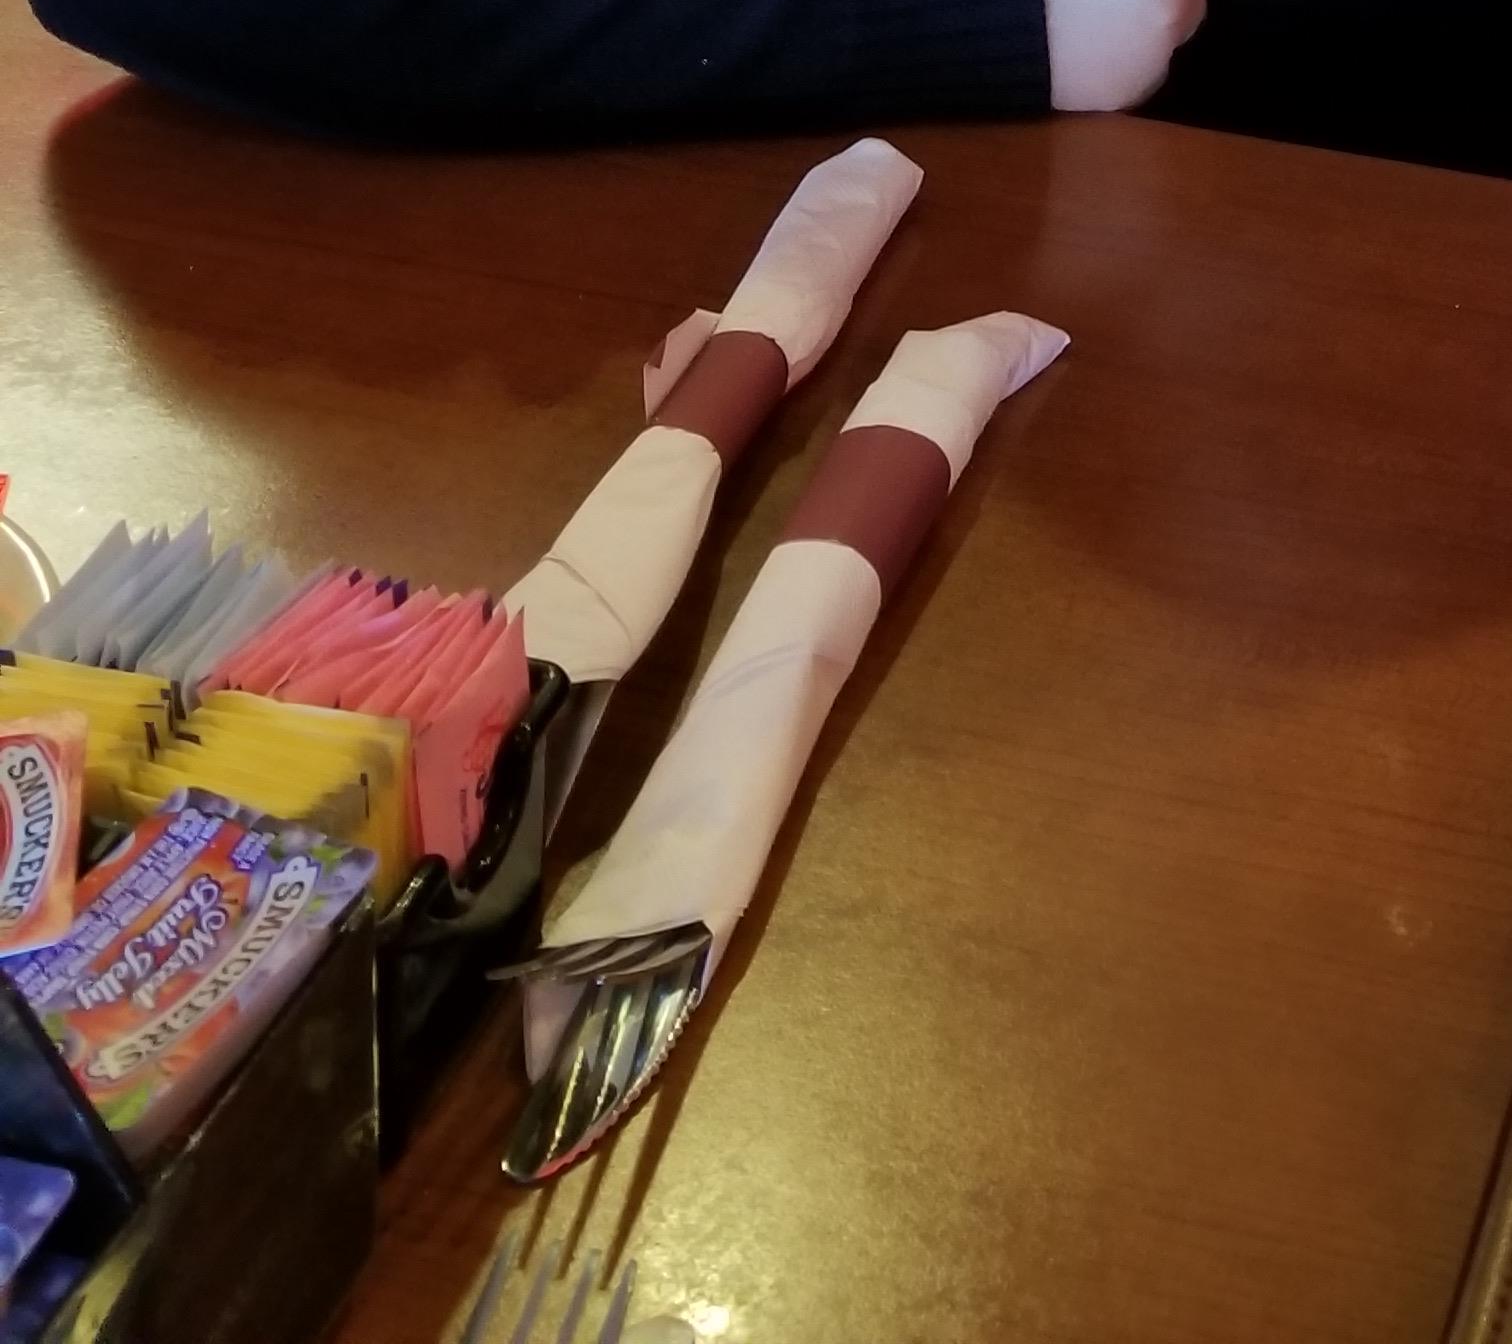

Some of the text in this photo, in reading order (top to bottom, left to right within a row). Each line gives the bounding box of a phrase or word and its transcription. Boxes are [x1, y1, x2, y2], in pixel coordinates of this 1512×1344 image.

[1, 756, 53, 921] SMUCKER'S
[132, 908, 229, 1010] Mixed
[145, 873, 221, 948] Fruit
[75, 936, 155, 1011] Jelly
[113, 878, 305, 1059] SMUCKER'S
